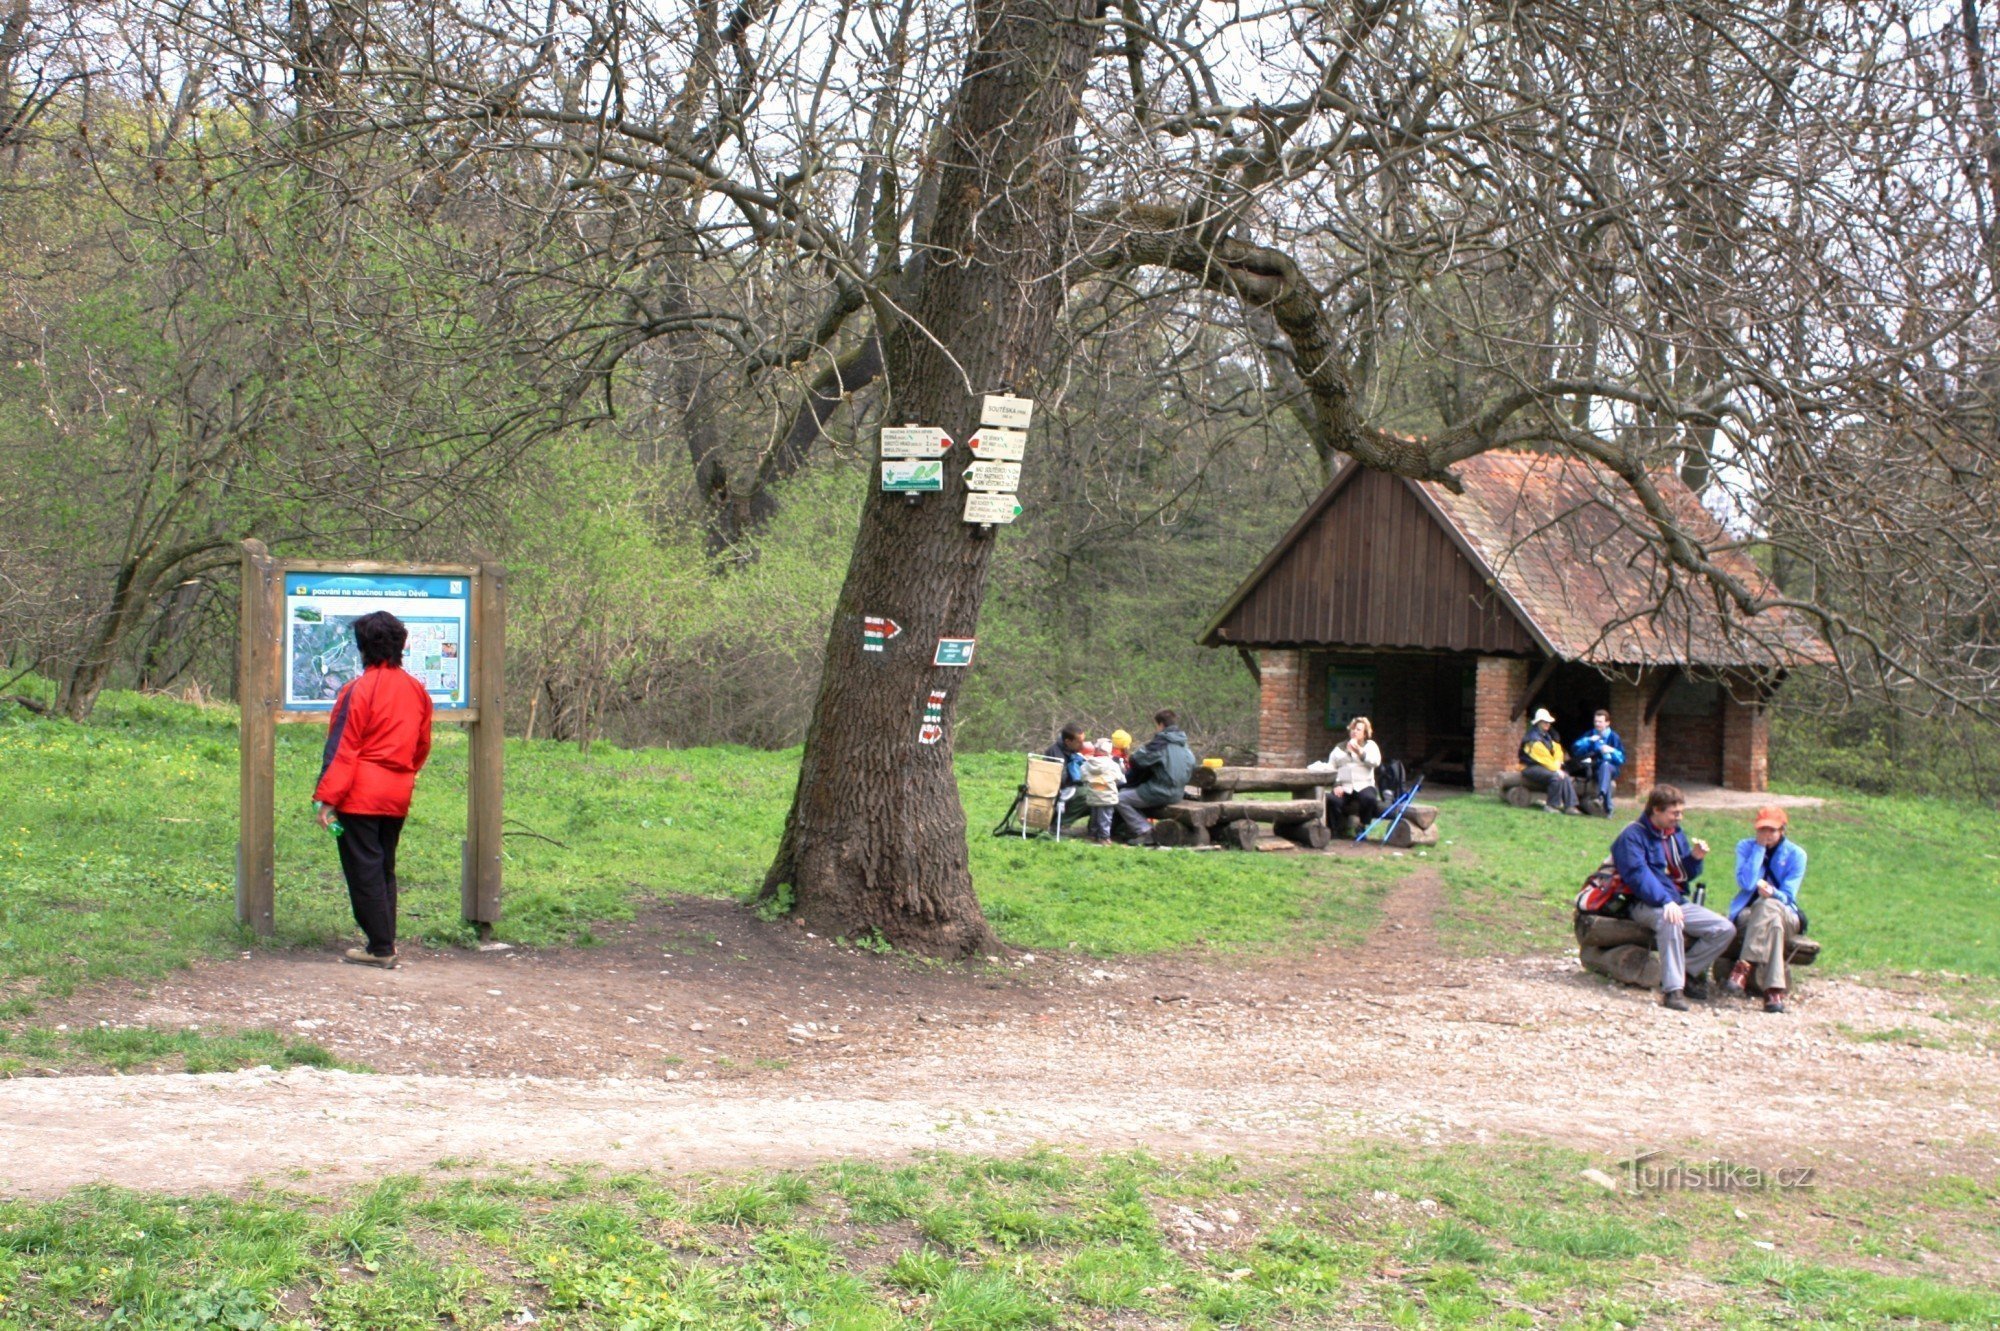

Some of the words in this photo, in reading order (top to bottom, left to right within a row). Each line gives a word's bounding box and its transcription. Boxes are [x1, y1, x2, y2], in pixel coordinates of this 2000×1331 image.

[312, 588, 341, 596] pozvání
[352, 588, 383, 596] naučnou
[384, 589, 407, 597] stezku
[408, 589, 429, 597] Děvín
